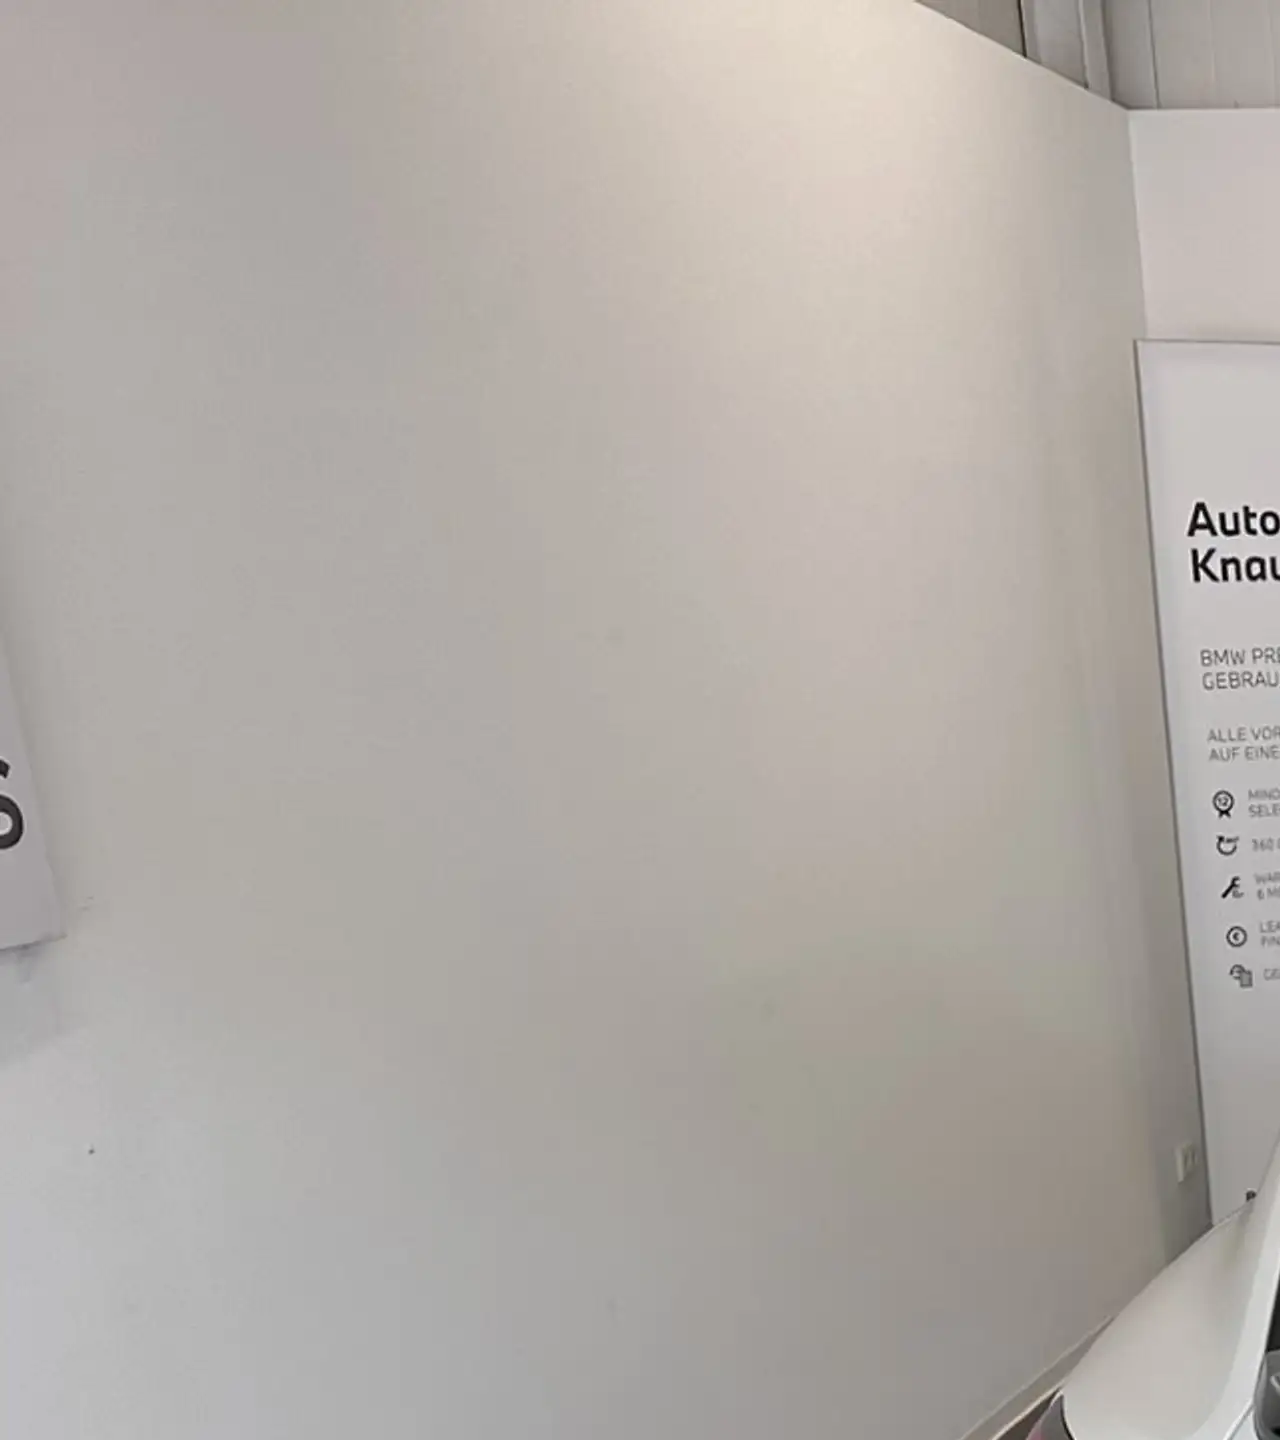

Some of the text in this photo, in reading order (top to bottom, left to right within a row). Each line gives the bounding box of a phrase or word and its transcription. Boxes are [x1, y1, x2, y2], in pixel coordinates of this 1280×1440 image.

[1200, 649, 1245, 667] BMW
[1207, 726, 1247, 743] ALLE
[1209, 747, 1240, 762] AUF
